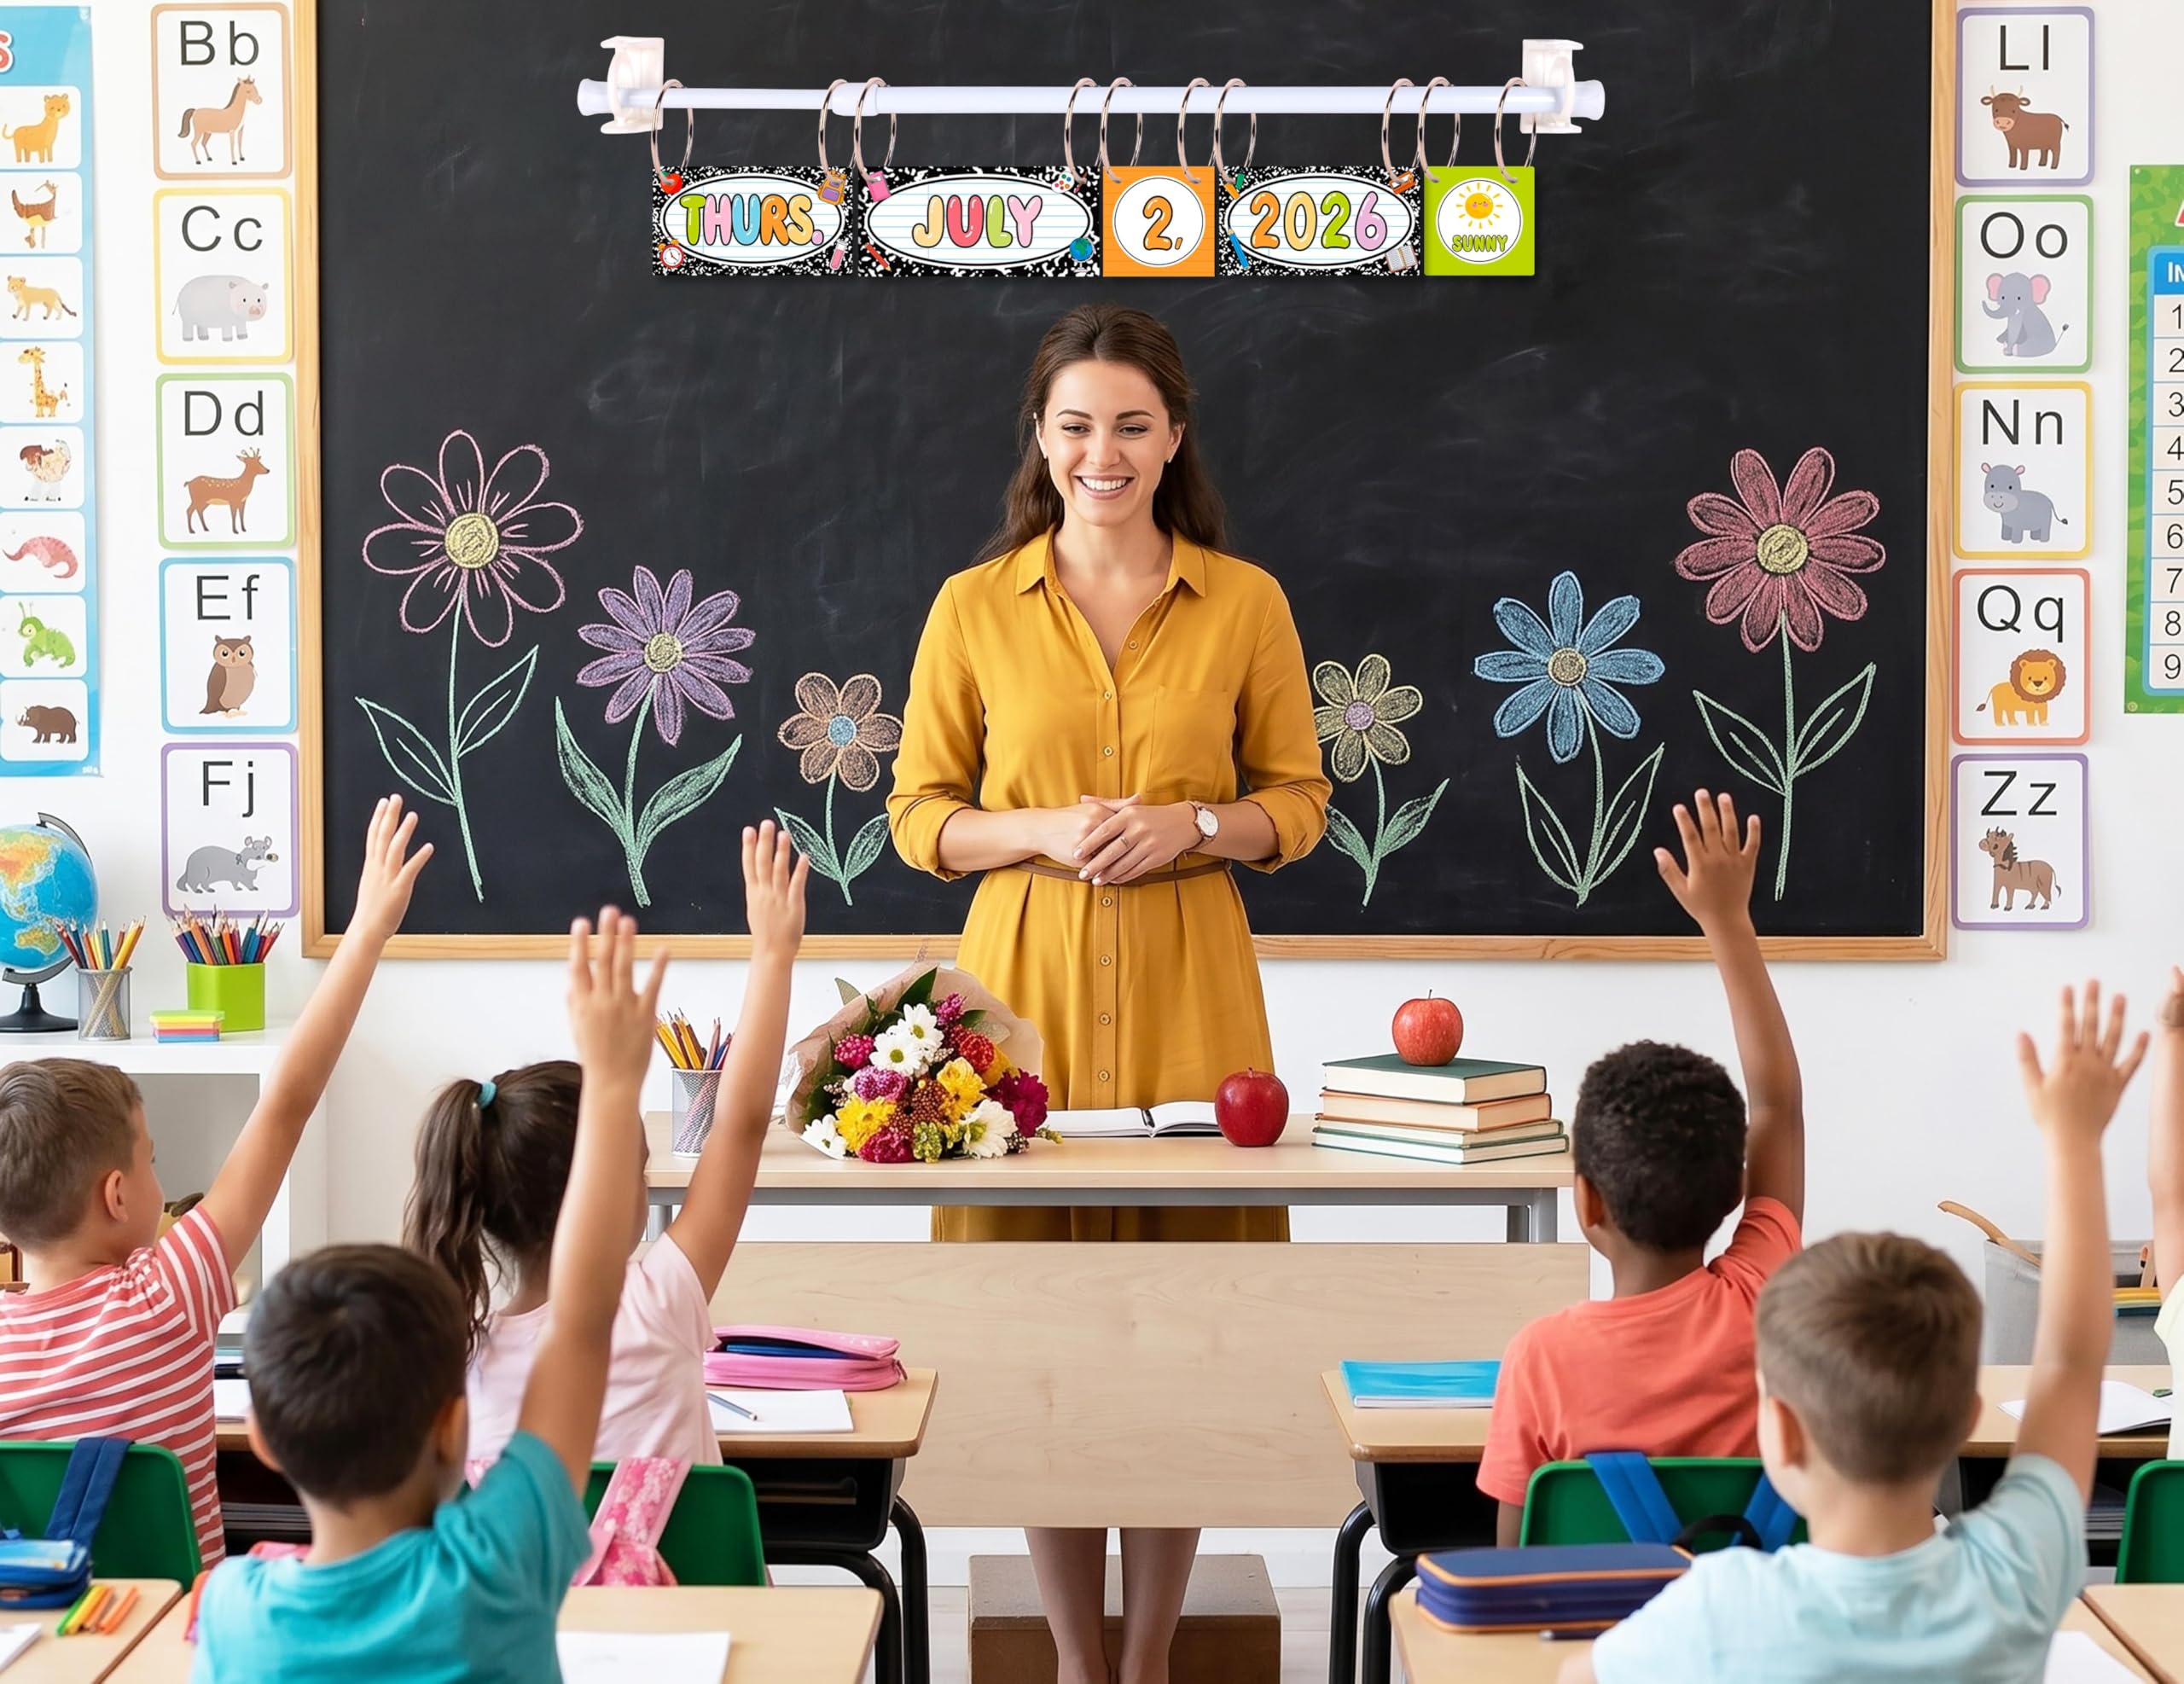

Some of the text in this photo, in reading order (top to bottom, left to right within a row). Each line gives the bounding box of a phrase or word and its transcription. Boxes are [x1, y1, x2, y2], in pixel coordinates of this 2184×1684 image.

[679, 190, 1509, 253] THURS. JULY 2, 2026 SUNNY
[2169, 347, 2184, 374] 2
[2169, 392, 2184, 418] 3
[2167, 436, 2184, 462] 4
[2168, 479, 2184, 506] 5
[2167, 523, 2184, 550] 6
[2165, 567, 2184, 595] 7
[2164, 610, 2182, 637] 8
[2164, 653, 2182, 681] 9
